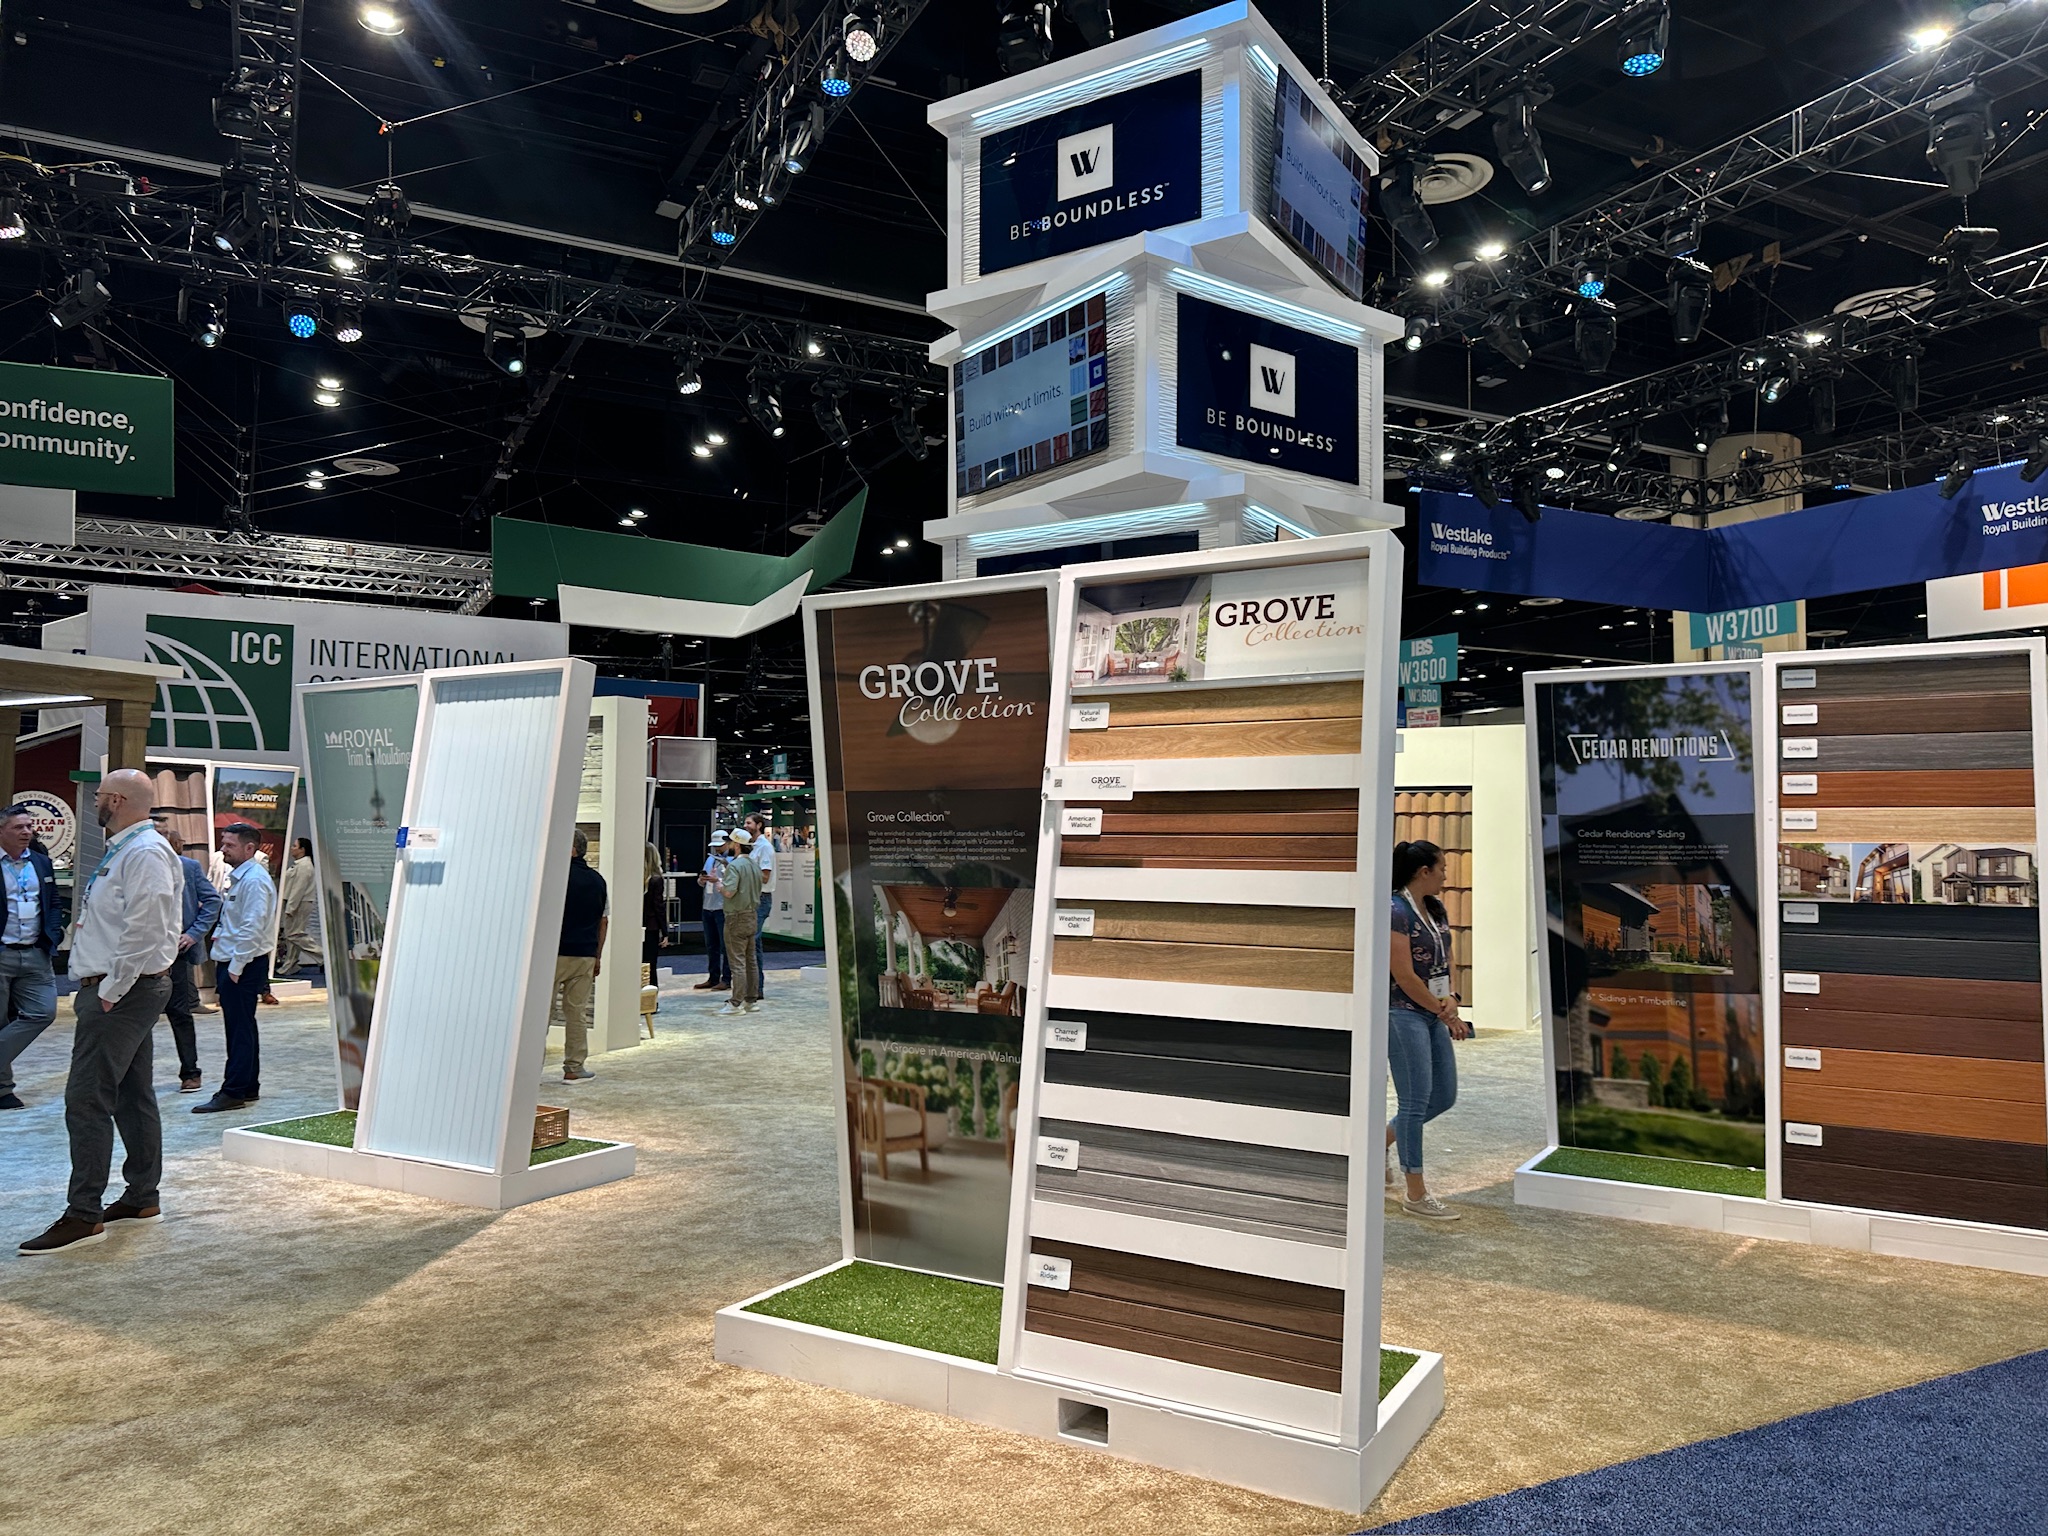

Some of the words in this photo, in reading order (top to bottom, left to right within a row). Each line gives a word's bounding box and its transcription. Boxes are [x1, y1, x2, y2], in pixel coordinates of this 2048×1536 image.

[1010, 221, 1031, 240] BE
[969, 411, 991, 432] Build
[994, 397, 1031, 422] without
[1206, 407, 1227, 427] BE
[1430, 522, 1493, 546] Westlake
[1982, 522, 2010, 536] Royal
[1430, 540, 1450, 555] Royal
[1450, 543, 1478, 559] Building
[1215, 594, 1335, 628] GROVE
[1705, 604, 1778, 644] W3700
[230, 630, 282, 665] ICC
[859, 657, 999, 699] GROVE
[1399, 656, 1447, 685] W3600
[1408, 688, 1438, 703] W3600
[1582, 739, 1627, 759] CEDAR
[1631, 735, 1718, 758] RENDITIONS
[346, 748, 363, 766] Trim
[1091, 776, 1121, 784] GROVE
[867, 811, 895, 822] Grove
[1577, 829, 1603, 838] Cedar
[1657, 829, 1685, 840] Siding
[1598, 994, 1627, 1005] Siding
[1628, 995, 1637, 1003] in
[1639, 996, 1687, 1007] Timberline
[1054, 1027, 1079, 1035] Charred
[1055, 1035, 1076, 1043] Timber
[881, 1041, 925, 1056] V-Groove
[929, 1046, 937, 1056] in
[939, 1046, 987, 1060] American
[1048, 1144, 1069, 1152] Smoke
[1050, 1152, 1065, 1161] Grey
[1040, 1271, 1058, 1281] Ridge
[1043, 1263, 1056, 1272] Oak
